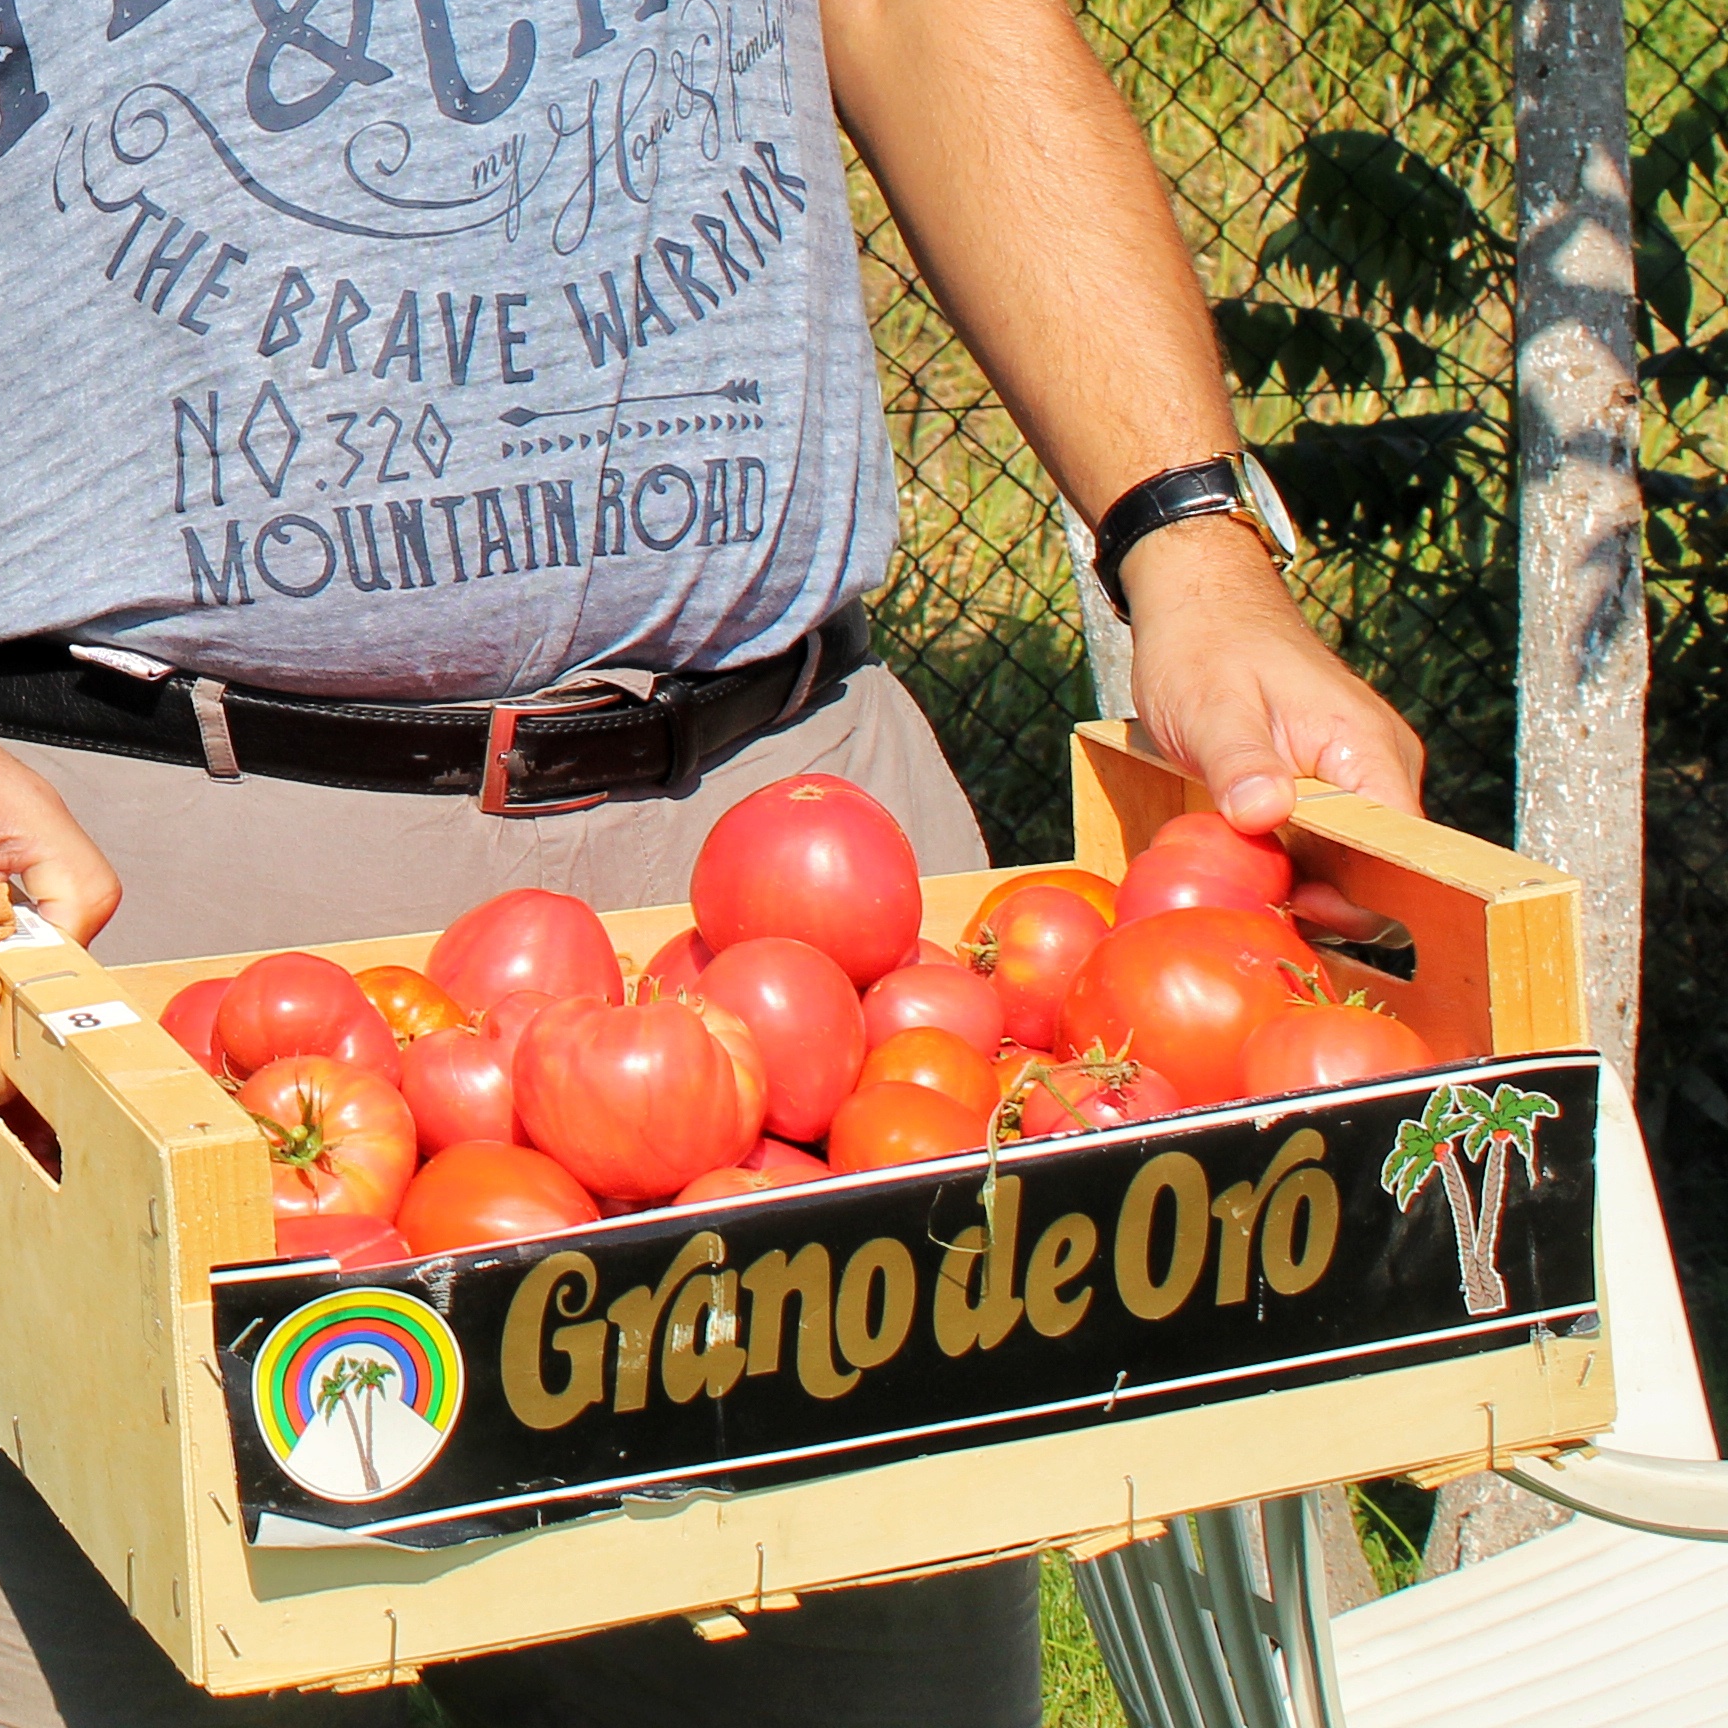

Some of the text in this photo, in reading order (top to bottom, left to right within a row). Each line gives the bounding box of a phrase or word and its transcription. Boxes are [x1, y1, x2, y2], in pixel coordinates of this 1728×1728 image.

[472, 133, 526, 242] my
[105, 141, 807, 385] THE BRAVE WARRIOR
[181, 457, 767, 606] MOUNTAIN ROAD
[68, 1012, 102, 1029] 8
[500, 1128, 1340, 1431] Grano de Oro
